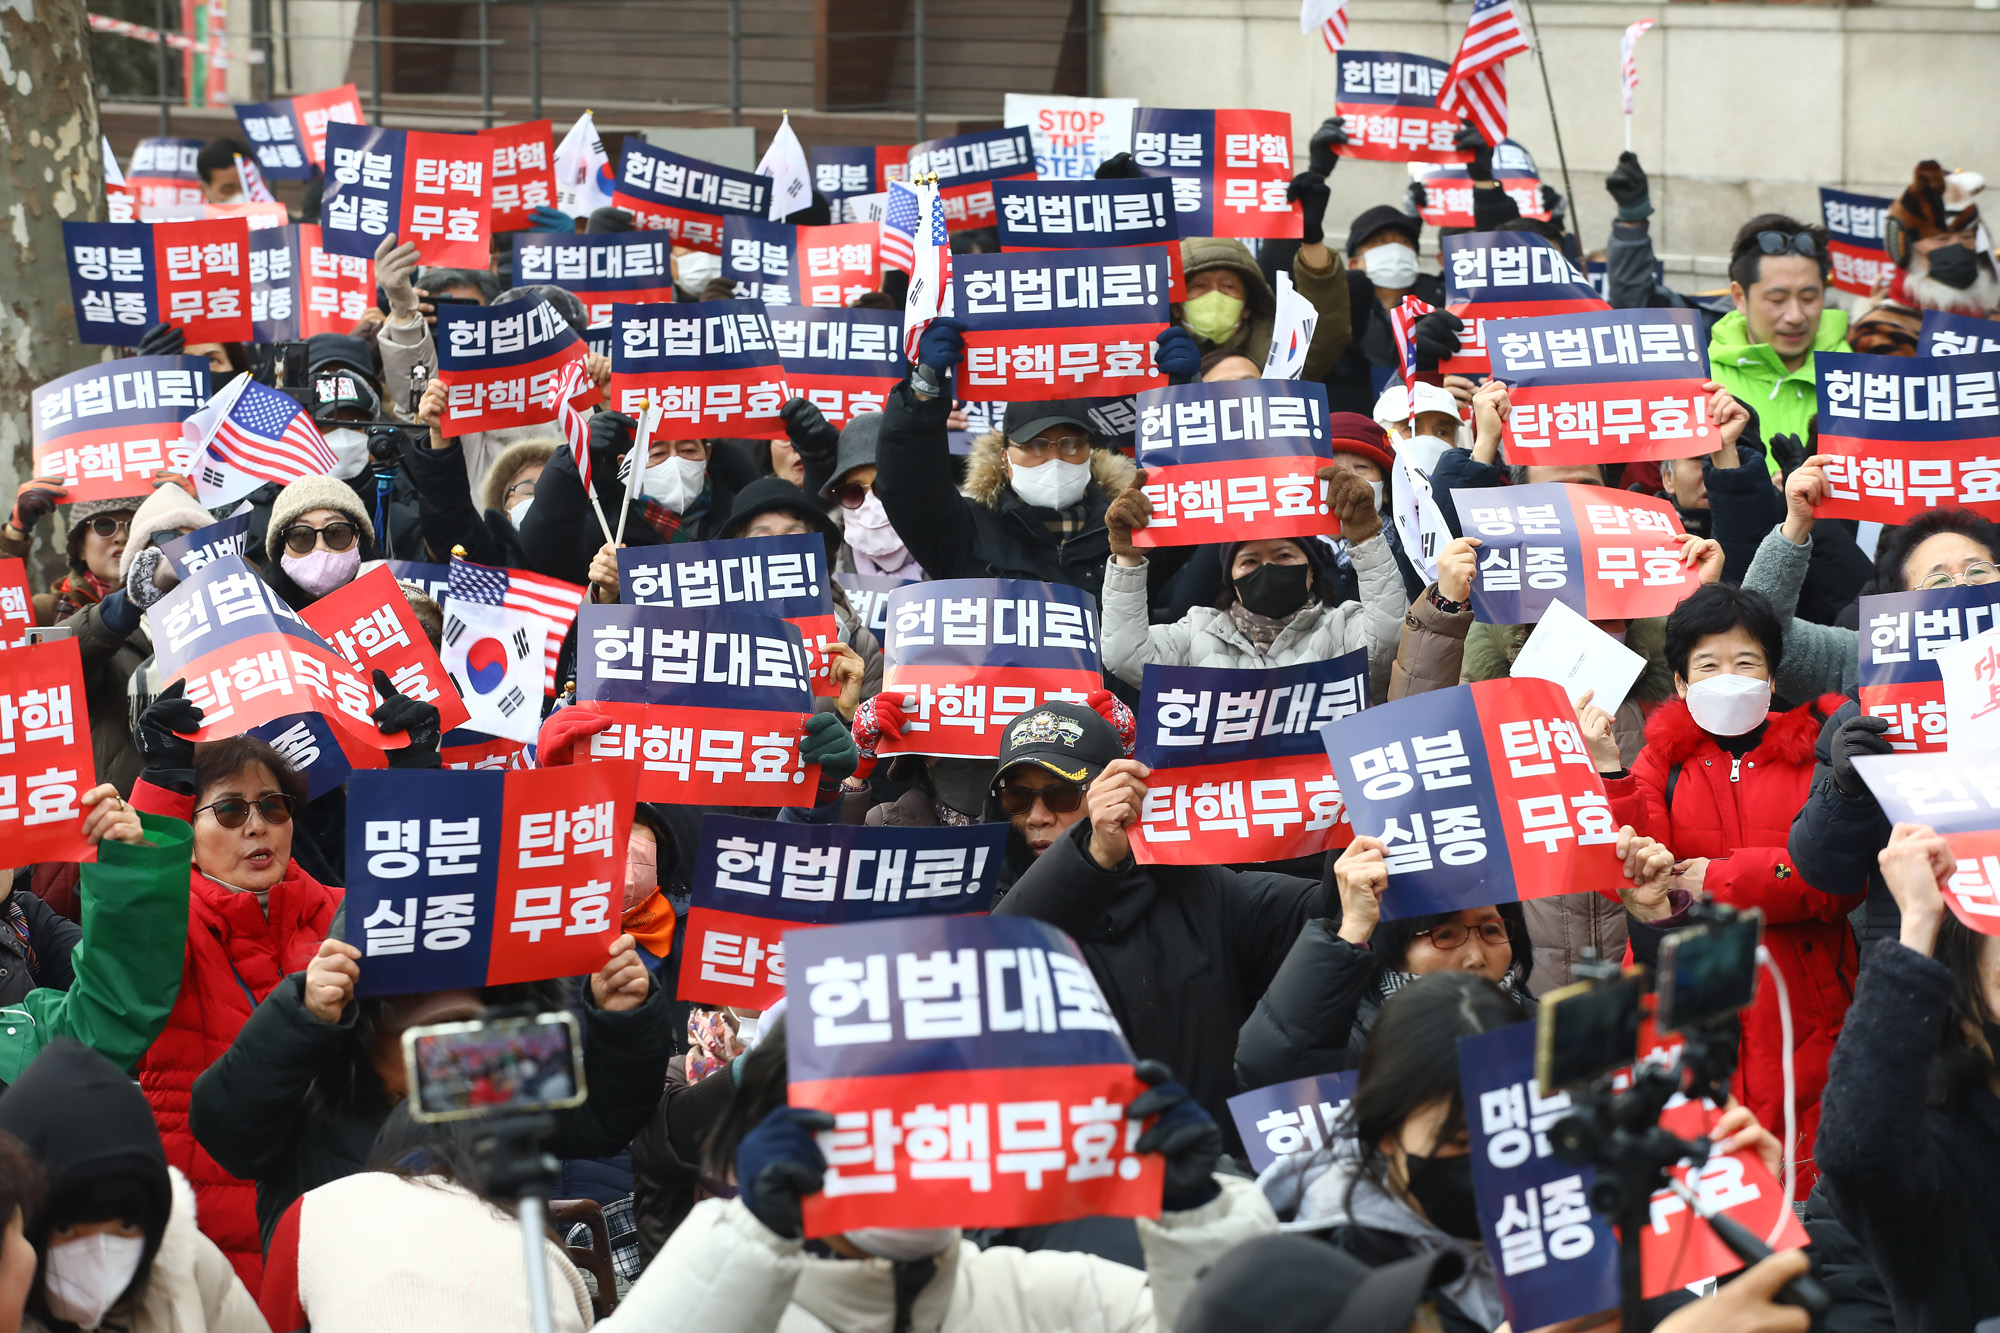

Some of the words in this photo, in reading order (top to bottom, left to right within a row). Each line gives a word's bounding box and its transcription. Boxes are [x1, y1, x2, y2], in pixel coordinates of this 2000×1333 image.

[1343, 61, 1447, 97] 헌법대
[244, 115, 295, 143] 명분
[1038, 110, 1104, 132] STOP
[1341, 114, 1455, 151] 탄핵무효
[493, 141, 547, 177] 탄핵
[909, 136, 1027, 179] 헌법대로!
[1048, 134, 1095, 155] THE
[1135, 131, 1202, 167] 명분
[1225, 134, 1290, 170] 탄핵
[333, 148, 392, 190] 명분
[415, 158, 483, 198] 탄핵
[625, 152, 763, 212] 헌법대로!
[816, 164, 868, 192] 명분
[1035, 155, 1102, 178] STEA
[329, 197, 389, 235] 실종
[492, 180, 550, 210] 무효
[1001, 193, 1167, 234] 헌법대로!
[1174, 178, 1202, 214] 종
[1225, 179, 1293, 213] 무효
[409, 206, 480, 243] 무효
[73, 246, 144, 281] 명분
[166, 242, 239, 281] 탄핵
[249, 246, 291, 283] 명분
[310, 247, 368, 283] 탄핵
[519, 241, 664, 281] 헌법대로!
[730, 239, 789, 276] 명분
[807, 244, 873, 278] 탄핵
[81, 290, 147, 325] 실종
[170, 287, 240, 322] 무효
[309, 287, 368, 320] 무효
[964, 264, 1159, 314] 헌법대로!
[621, 313, 775, 360] 헌법대로!
[770, 319, 899, 363] 법대로!
[1497, 324, 1699, 372] 헌법대로!
[968, 340, 1160, 385] 탄핵무효!
[39, 370, 205, 430] 헌법대로!
[621, 381, 791, 423] 탄핵무효!
[1141, 397, 1323, 451] 헌법대로!
[1509, 396, 1709, 448] 탄핵무효!
[41, 436, 195, 486] 탄핵무효
[1823, 454, 2000, 506] 탄핵무효
[1147, 472, 1330, 528] 탄핵무효!
[1471, 504, 1561, 536] 명분
[1586, 505, 1677, 536] 탄핵
[629, 553, 819, 608] 헌법대로!
[1479, 547, 1568, 592] 실종
[1597, 547, 1686, 589] 무효
[895, 598, 1096, 652] 헌법대로!
[592, 624, 808, 692] 헌법대로!
[1156, 673, 1366, 746] 헌법대로!
[589, 724, 806, 784] 탄핵무효!
[1350, 730, 1472, 800] 명분
[1499, 717, 1594, 778] 탄핵
[1141, 776, 1349, 842] 탄핵무효
[1518, 790, 1619, 853] 무효
[364, 818, 481, 879] 명분
[518, 801, 614, 869] 탄핵
[1377, 806, 1488, 875] 실종
[714, 835, 989, 901] 헌법대로!
[362, 894, 475, 957] 실종
[509, 881, 611, 943] 무효
[806, 948, 1117, 1046] 헌법대로
[818, 1097, 1142, 1197] 탄핵무효!
[1496, 1174, 1595, 1277] 실종
